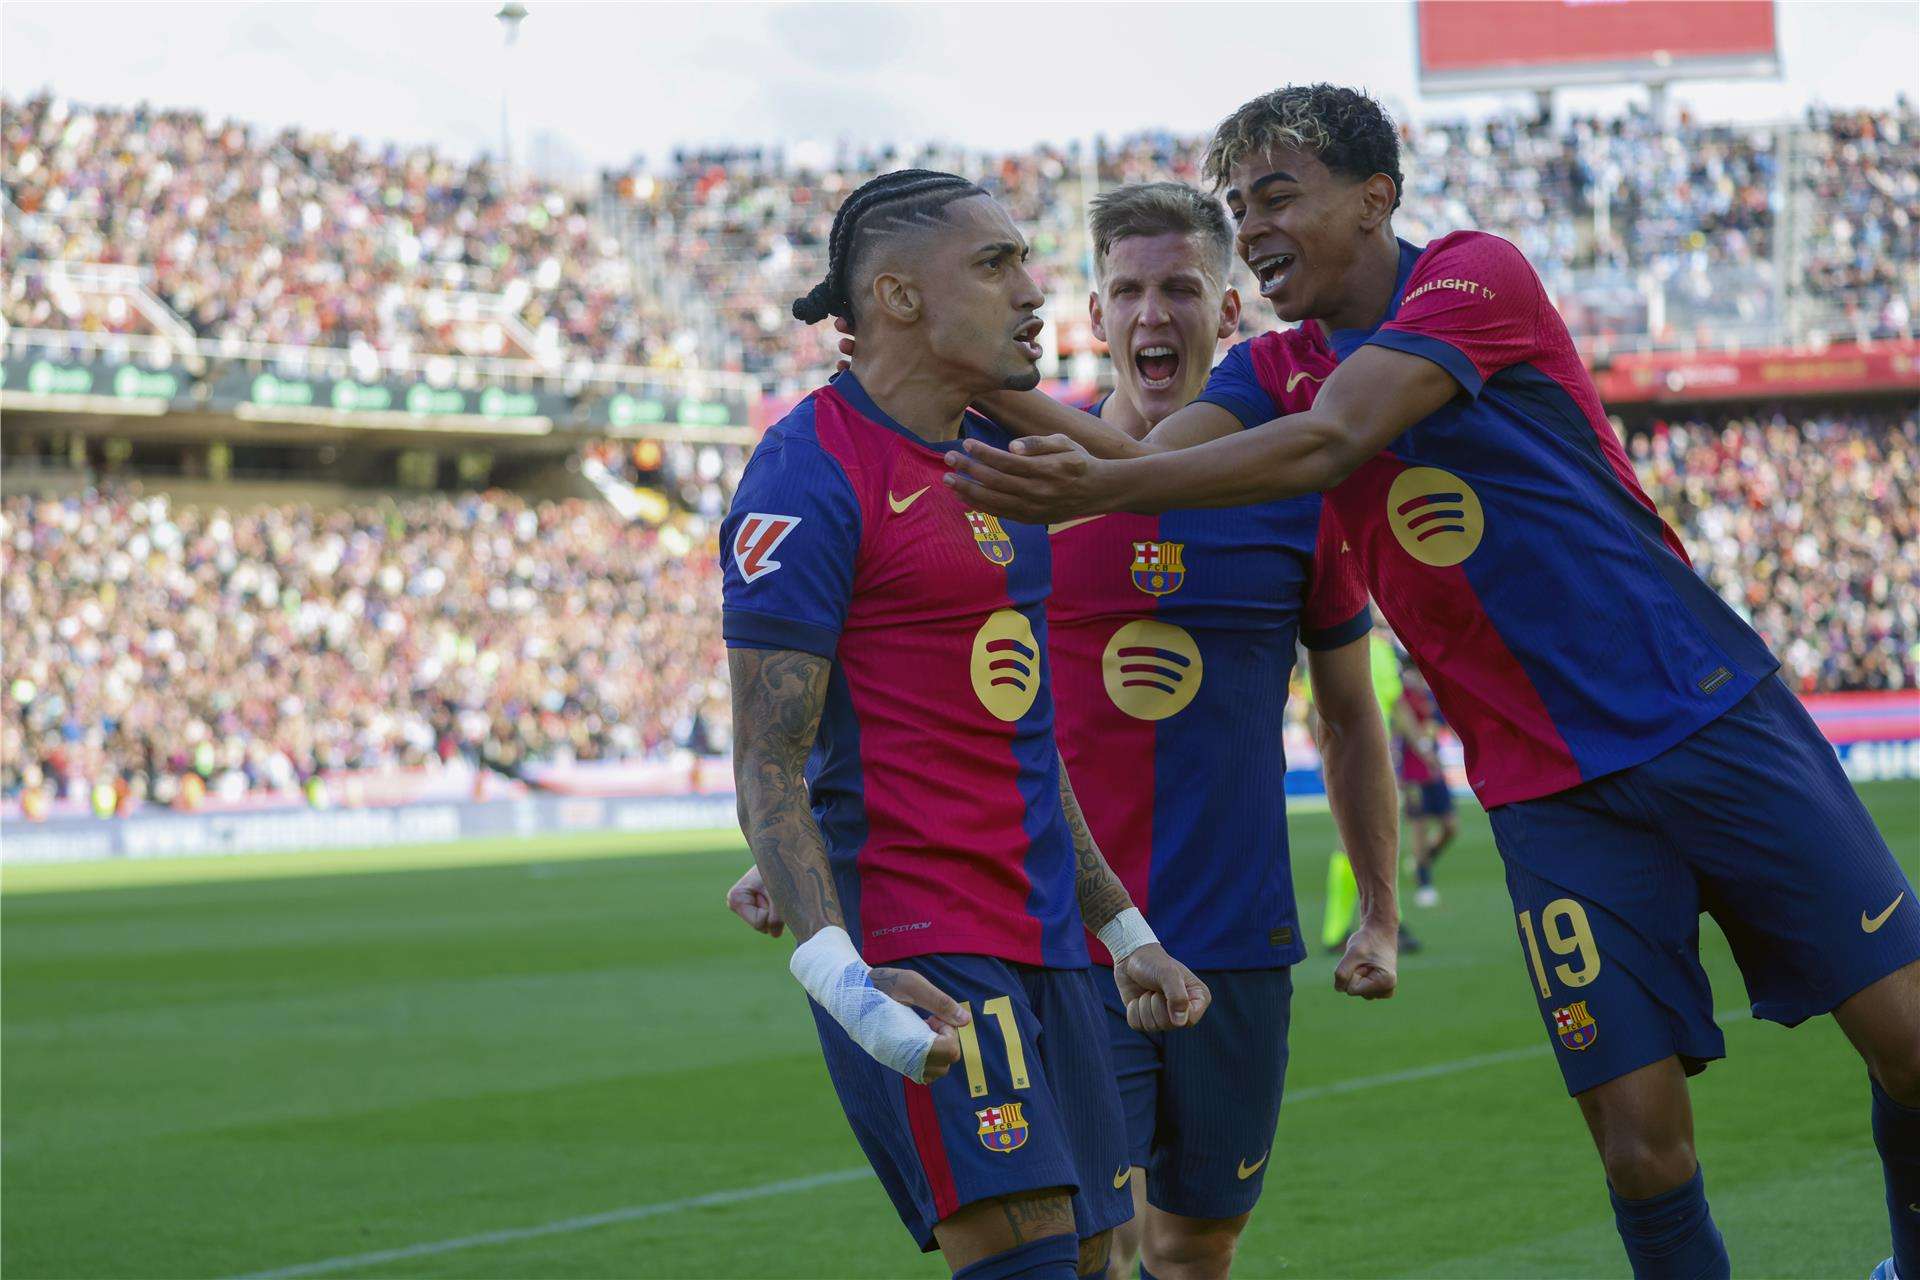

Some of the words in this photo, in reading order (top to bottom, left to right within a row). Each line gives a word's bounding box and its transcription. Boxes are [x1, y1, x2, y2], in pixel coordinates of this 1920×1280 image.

[1147, 564, 1169, 572] FCB
[1518, 898, 1601, 999] 19
[957, 995, 1031, 1098] 11
[992, 1122, 1013, 1132] FCB
